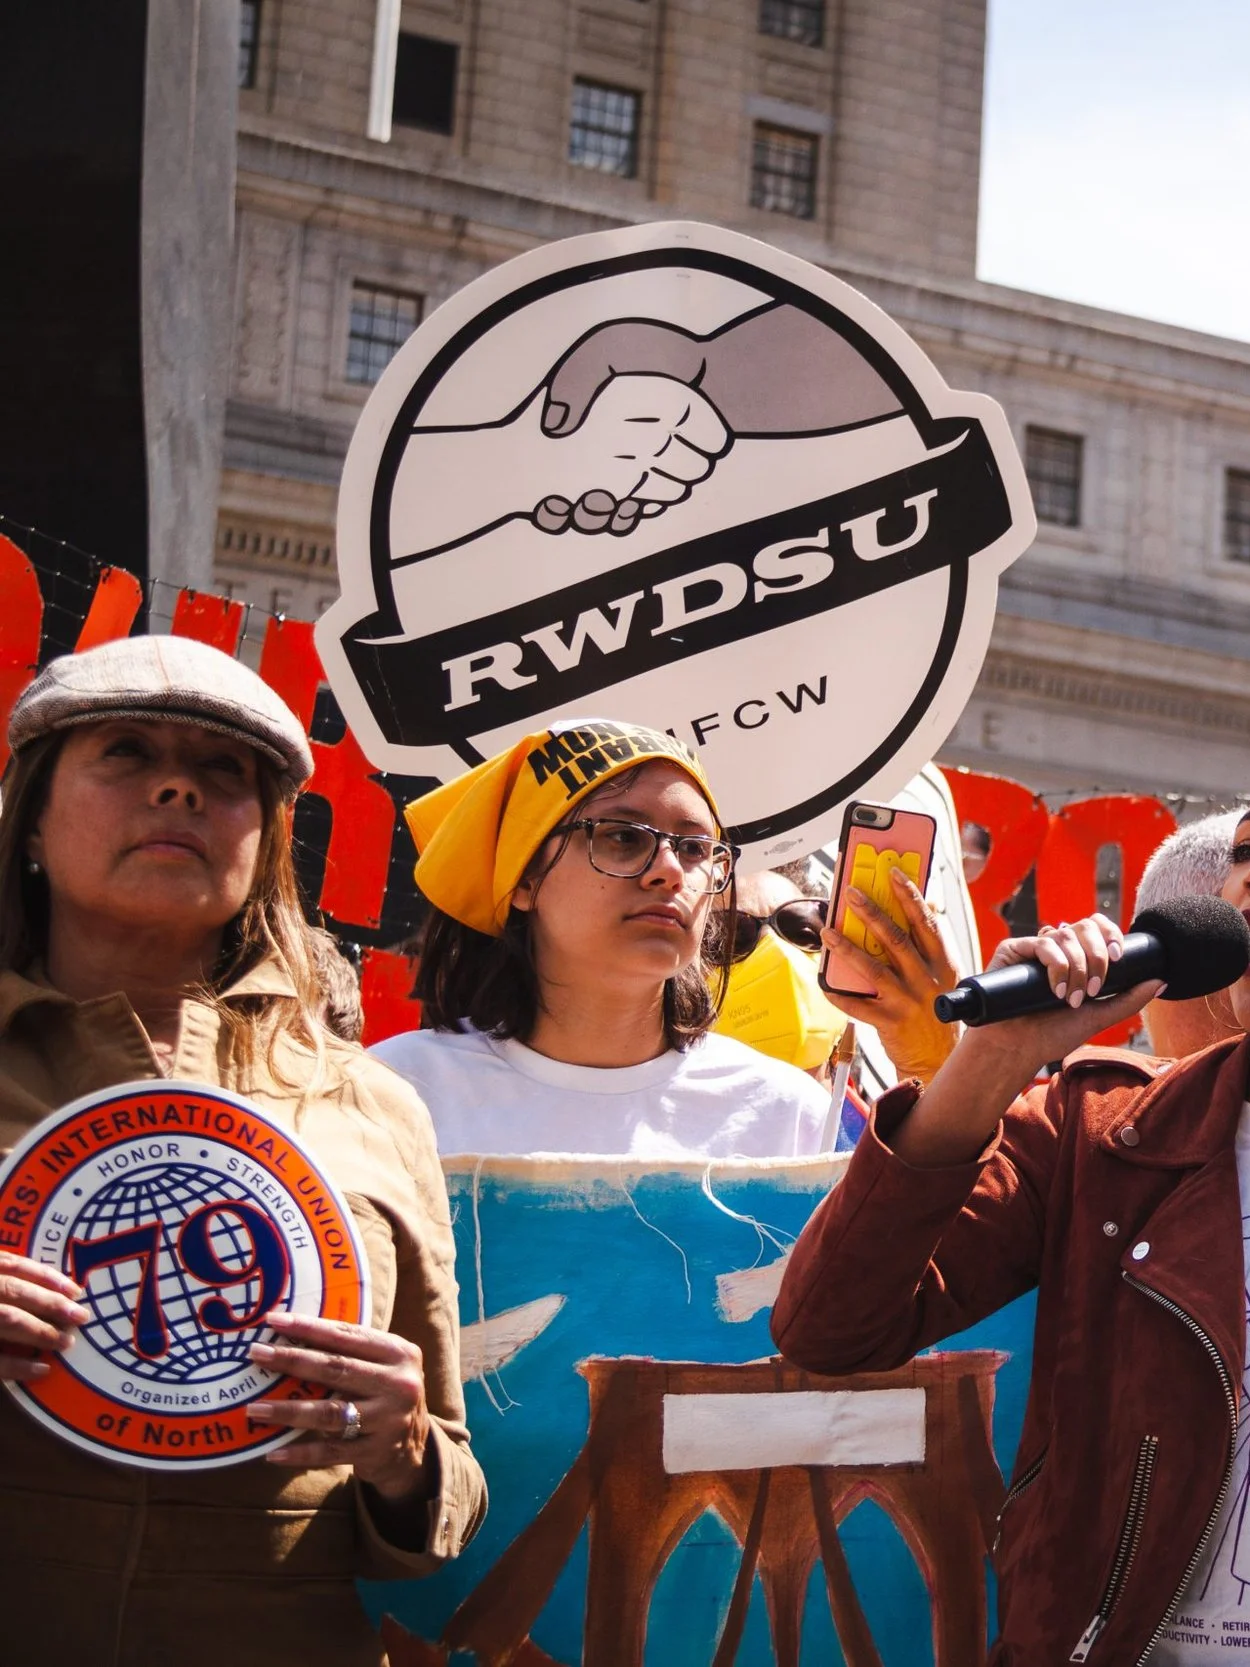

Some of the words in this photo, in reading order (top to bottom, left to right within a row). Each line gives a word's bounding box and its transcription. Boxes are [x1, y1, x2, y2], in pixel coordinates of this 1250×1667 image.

[442, 488, 940, 713] RWDSU
[527, 721, 628, 787] NOW
[666, 675, 828, 747] FCW
[40, 1104, 288, 1174] INTERNATIONAL
[297, 1175, 350, 1271] UNION
[97, 1142, 181, 1177] HONOR
[227, 1156, 308, 1249] STRENGTH
[69, 1200, 292, 1361] 79
[96, 1413, 131, 1437] of
[142, 1420, 234, 1448] North
[121, 1381, 211, 1406] Organized
[218, 1375, 258, 1403] April
